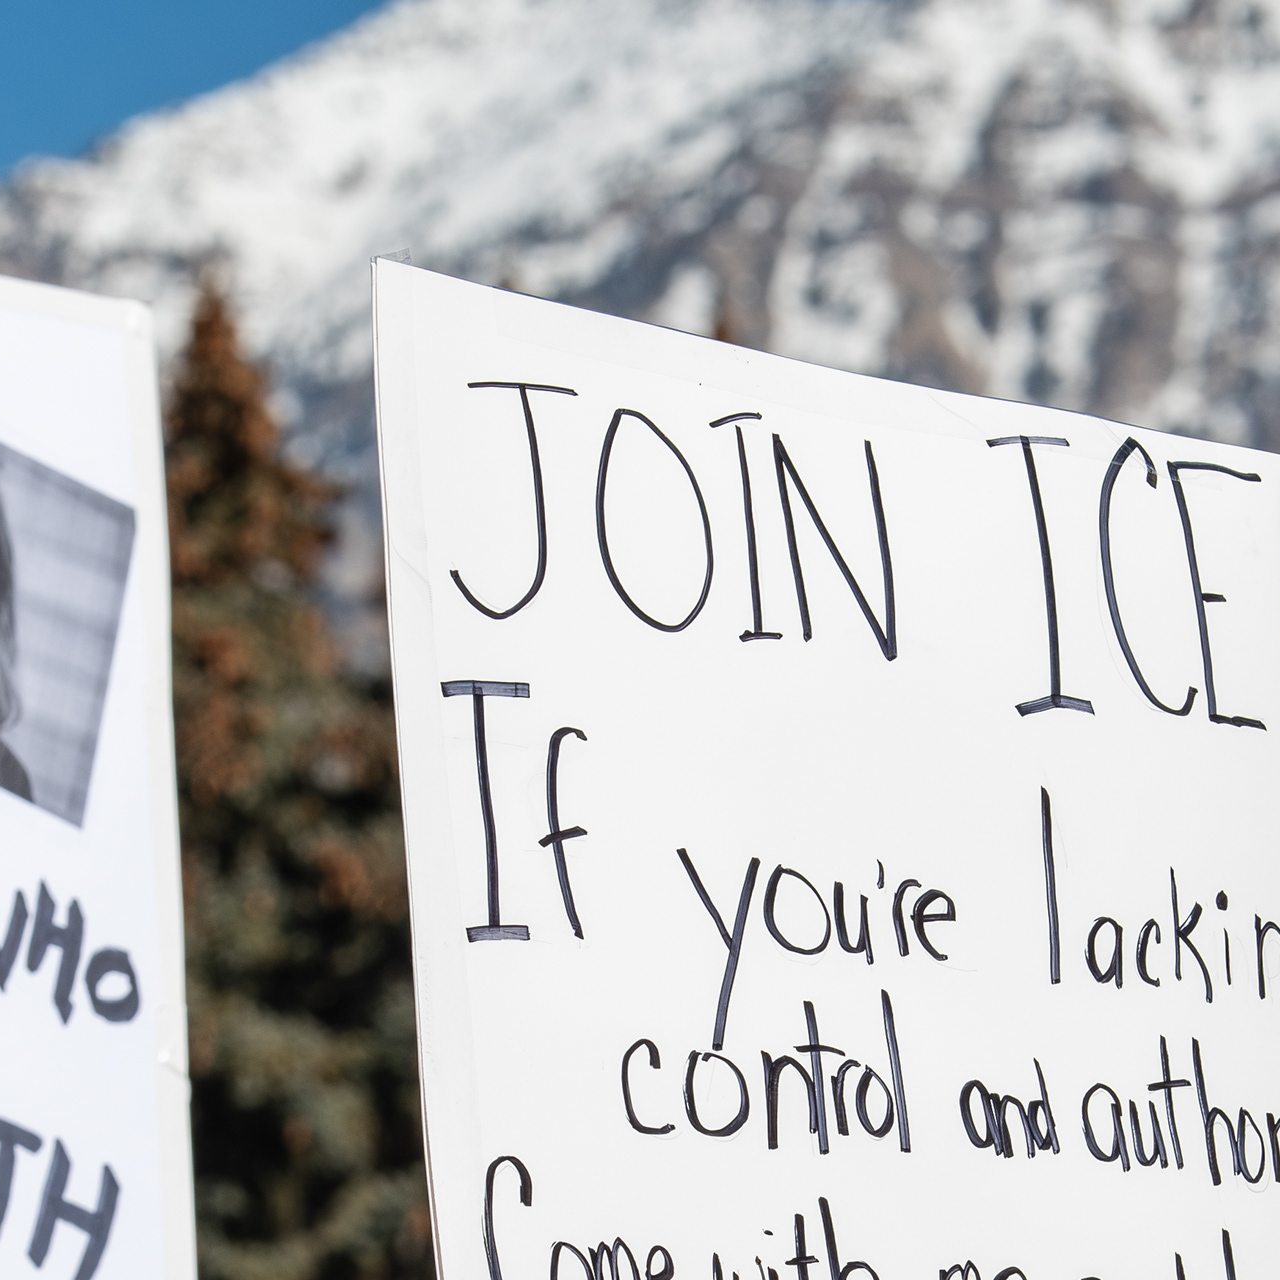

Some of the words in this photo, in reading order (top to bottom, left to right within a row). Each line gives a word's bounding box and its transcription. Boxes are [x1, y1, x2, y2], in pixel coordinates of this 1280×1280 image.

[450, 381, 897, 661] JOIN
[440, 680, 588, 942] If
[677, 848, 957, 1050] you're
[621, 989, 912, 1155] control
[960, 1057, 1061, 1159] and
